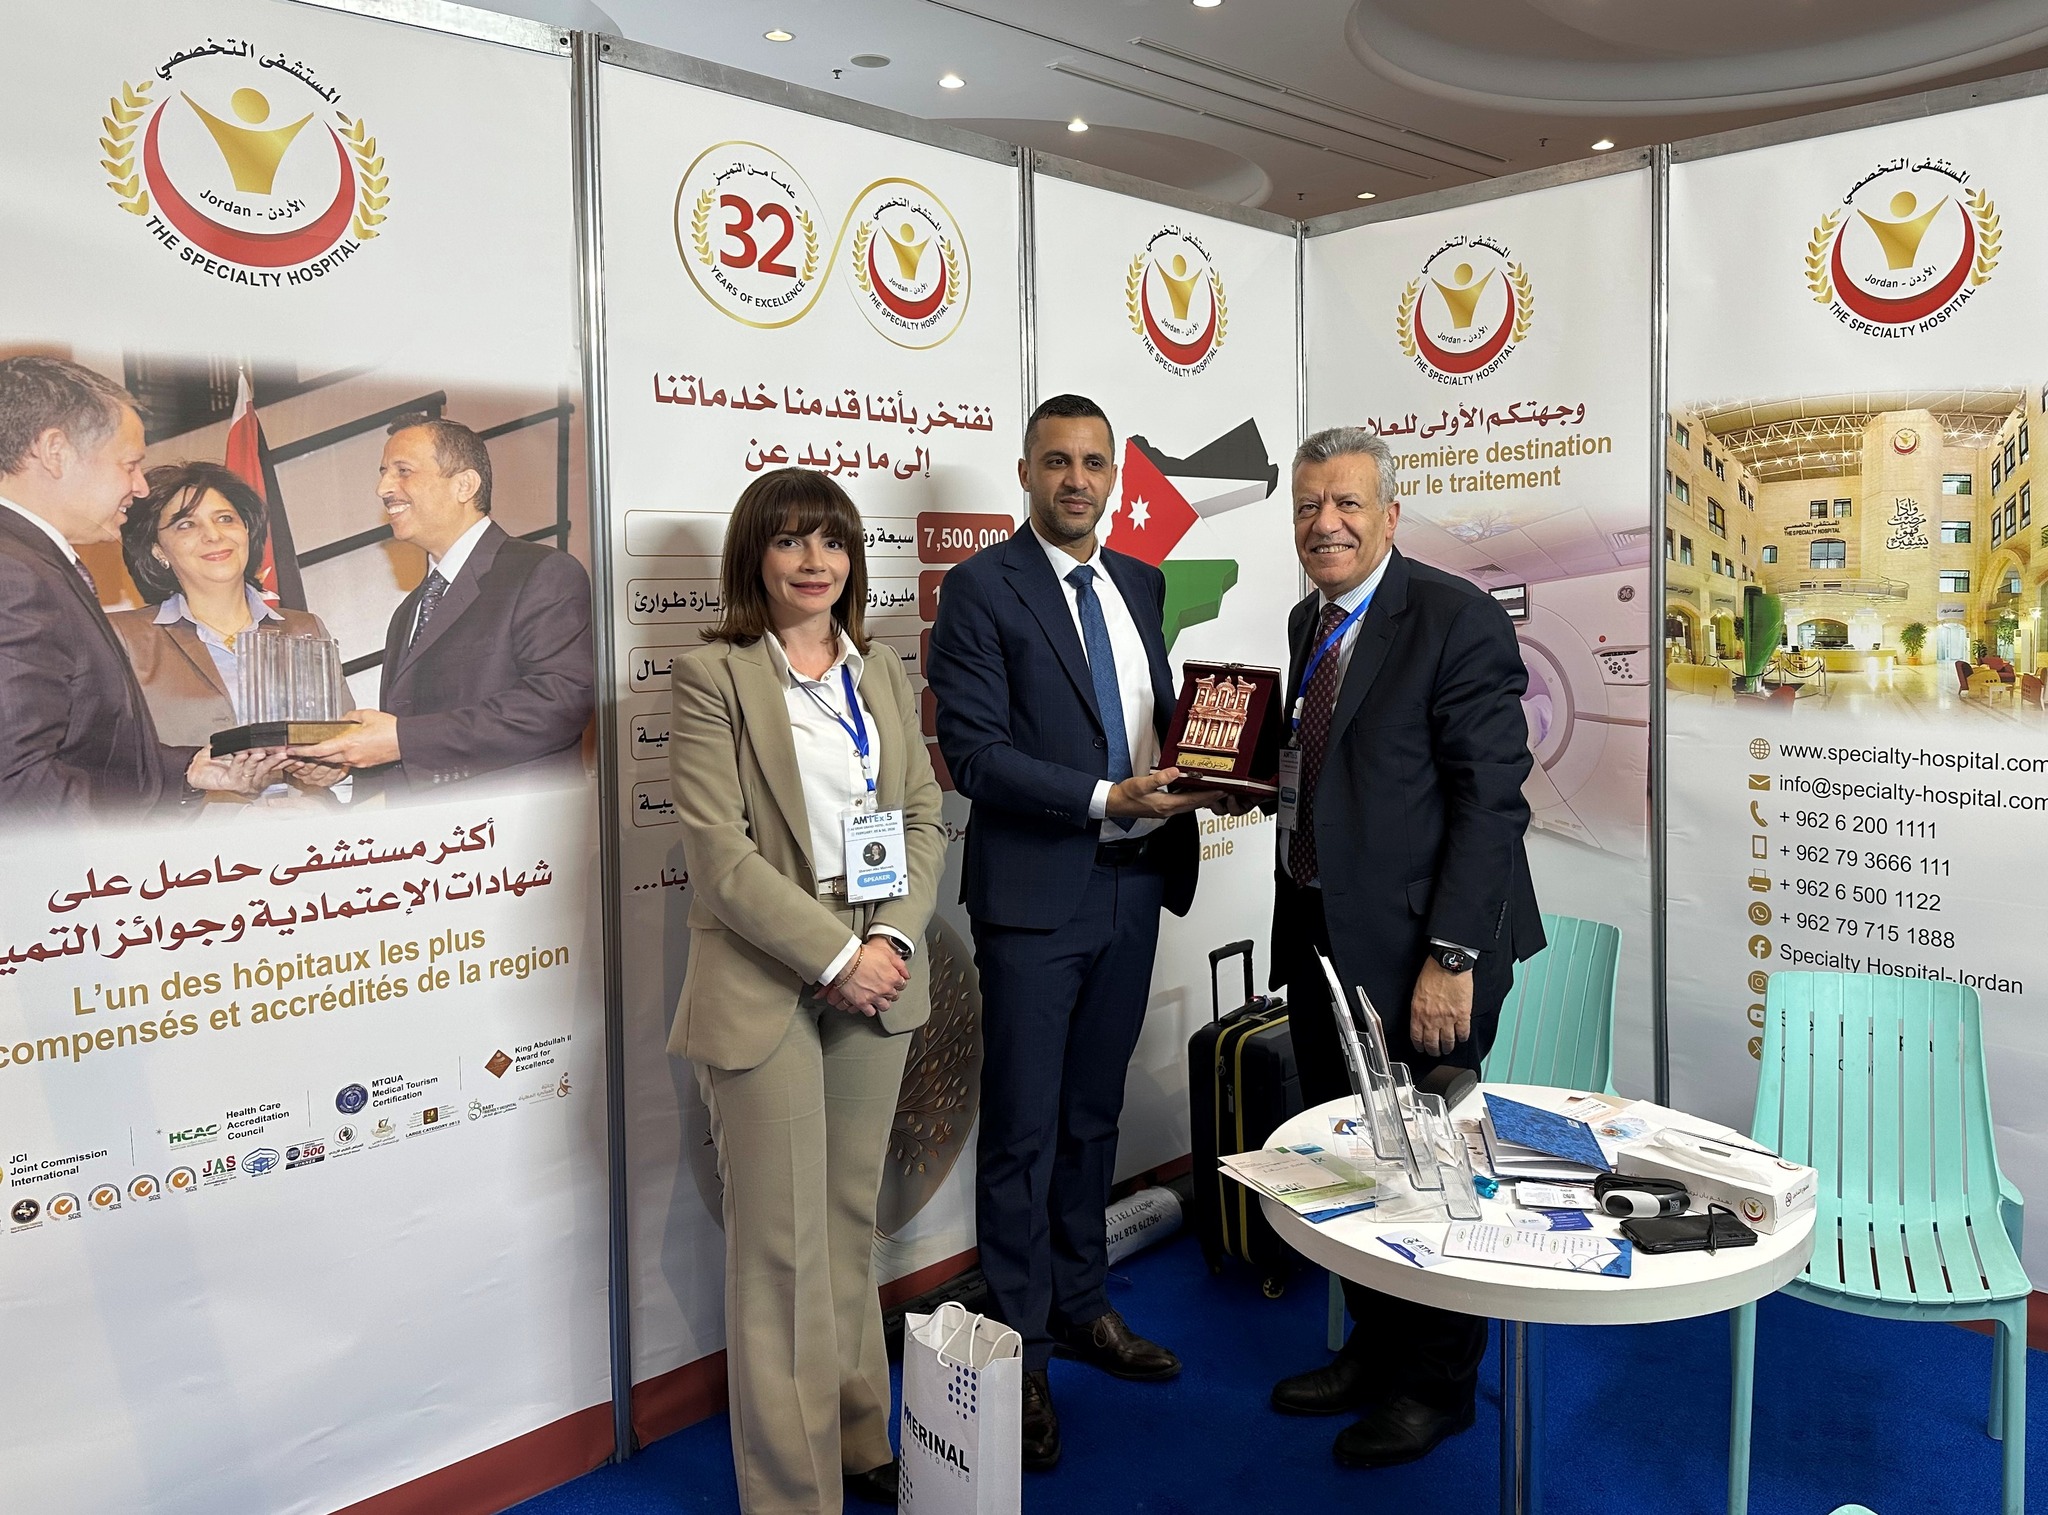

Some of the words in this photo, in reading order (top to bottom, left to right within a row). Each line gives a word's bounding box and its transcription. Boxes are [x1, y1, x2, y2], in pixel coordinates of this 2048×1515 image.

[155, 38, 254, 81] التخصصي
[259, 53, 341, 104] المستشفى
[713, 162, 746, 186] التميز
[747, 164, 768, 177] من
[1842, 157, 1909, 205] التخصصي
[1911, 156, 1971, 184] المستشفى
[199, 189, 251, 217] Jordan
[268, 199, 306, 220] الأردن
[872, 197, 910, 221] التخصصي
[910, 203, 942, 232] المستشفى
[145, 215, 180, 250] THE
[179, 247, 282, 287] SPECIALTY
[286, 239, 361, 286] HOSPITAL
[719, 193, 797, 278] 32
[1146, 224, 1181, 253] التخصصي
[1182, 231, 1212, 263] المستشفى
[1468, 235, 1511, 259] المستشفى
[1420, 234, 1468, 275] التخصصي
[711, 265, 738, 296] YEARS
[739, 292, 753, 304] OF
[755, 278, 806, 308] EXCELLENCE
[888, 277, 909, 293] Jordan
[1864, 273, 1898, 288] Jordan
[868, 291, 881, 310] THE
[881, 308, 919, 331] SPECIALTY
[920, 303, 949, 329] HOSPITAL
[1161, 317, 1180, 334] Jordan
[1828, 301, 1851, 324] THE
[1849, 318, 1916, 339] SPECIALTY
[1919, 286, 1976, 333] HOSPITAL
[1437, 332, 1461, 344] Jordan
[1142, 334, 1155, 356] THE
[1154, 353, 1191, 378] SPECIALTY
[1191, 347, 1218, 376] HOSPITAL
[1413, 354, 1429, 373] THE
[1427, 368, 1474, 386] SPECIALTY
[1475, 343, 1516, 381] HOSPITAL
[653, 371, 779, 415] خدماتنا
[784, 384, 861, 420] قدمنا
[866, 389, 918, 435] بأننا
[916, 400, 994, 435] نفتخر
[1355, 413, 1418, 438] للعلا
[1420, 401, 1484, 440] الأولى
[1486, 400, 1586, 436] وجهتكم
[744, 437, 790, 472] عن
[797, 440, 861, 478] يزيد
[867, 442, 890, 471] ما
[894, 445, 931, 480] إلى
[1485, 434, 1612, 465] destination
[1393, 477, 1420, 497] our
[1426, 473, 1443, 495] le
[1449, 464, 1561, 494] traitement
[877, 527, 914, 550] سبعة
[923, 527, 1009, 553] 7,500,000
[634, 591, 687, 614] طوارئ
[880, 587, 915, 607] مليون
[1779, 742, 2048, 774] www.specialty-hospital.com
[1779, 774, 2048, 811] info@specialty-hospital.com
[1796, 810, 1830, 830] 962
[1835, 814, 1846, 831] 6
[1852, 815, 1888, 835] 200
[1895, 819, 1937, 839] 1111
[426, 817, 496, 865] أكثر
[1200, 836, 1234, 861] anie
[269, 837, 426, 886] مستشفى
[1796, 844, 1829, 864] 962
[1835, 848, 1858, 867] 79
[1864, 850, 1912, 873] 3666
[1919, 857, 1950, 877] 111
[47, 867, 133, 914] على
[140, 854, 263, 900] حاصل
[445, 859, 553, 902] شهادات
[863, 873, 891, 883] SPEAKER
[248, 877, 439, 937] الإعتمادية
[1796, 878, 1829, 898] 962
[1835, 883, 1846, 900] 6
[1852, 885, 1887, 905] 500
[1895, 890, 1941, 911] 1122
[101, 913, 246, 960] وجوائز
[1796, 912, 1829, 932] 962
[1835, 918, 1858, 936] 79
[1864, 922, 1899, 942] 715
[1907, 928, 1955, 949] 1888
[0, 923, 101, 976] التمي
[160, 970, 222, 1001] des
[233, 947, 371, 991] hôpitaux
[380, 939, 420, 966] les
[429, 927, 486, 964] plus
[1780, 943, 1861, 973] Specialty
[209, 1000, 241, 1031] et
[250, 974, 408, 1023] accrédités
[417, 966, 450, 993] de
[459, 959, 481, 985] la
[489, 945, 570, 979] region
[514, 1045, 532, 1054] King
[533, 1036, 566, 1049] Abdullah
[515, 1053, 538, 1063] Award
[371, 1073, 404, 1087] MTQUA
[515, 1058, 555, 1072] Excellence
[372, 1084, 404, 1098] Medical
[406, 1076, 439, 1091] Tourism
[372, 1090, 423, 1108] Certification
[226, 1106, 257, 1120] Health
[258, 1102, 281, 1113] Care
[226, 1110, 290, 1130] Accreditation
[168, 1123, 219, 1144] HCAC
[227, 1125, 265, 1141] Council
[9, 1153, 28, 1165] JCI
[10, 1163, 39, 1176] Joint
[41, 1149, 108, 1169] Commission
[202, 1155, 236, 1175] JAS
[302, 1145, 325, 1158] 500
[11, 1165, 79, 1187] International
[1124, 1224, 1138, 1237] 828
[1138, 1212, 1162, 1231] +96279
[903, 1401, 970, 1474] MERINAL
